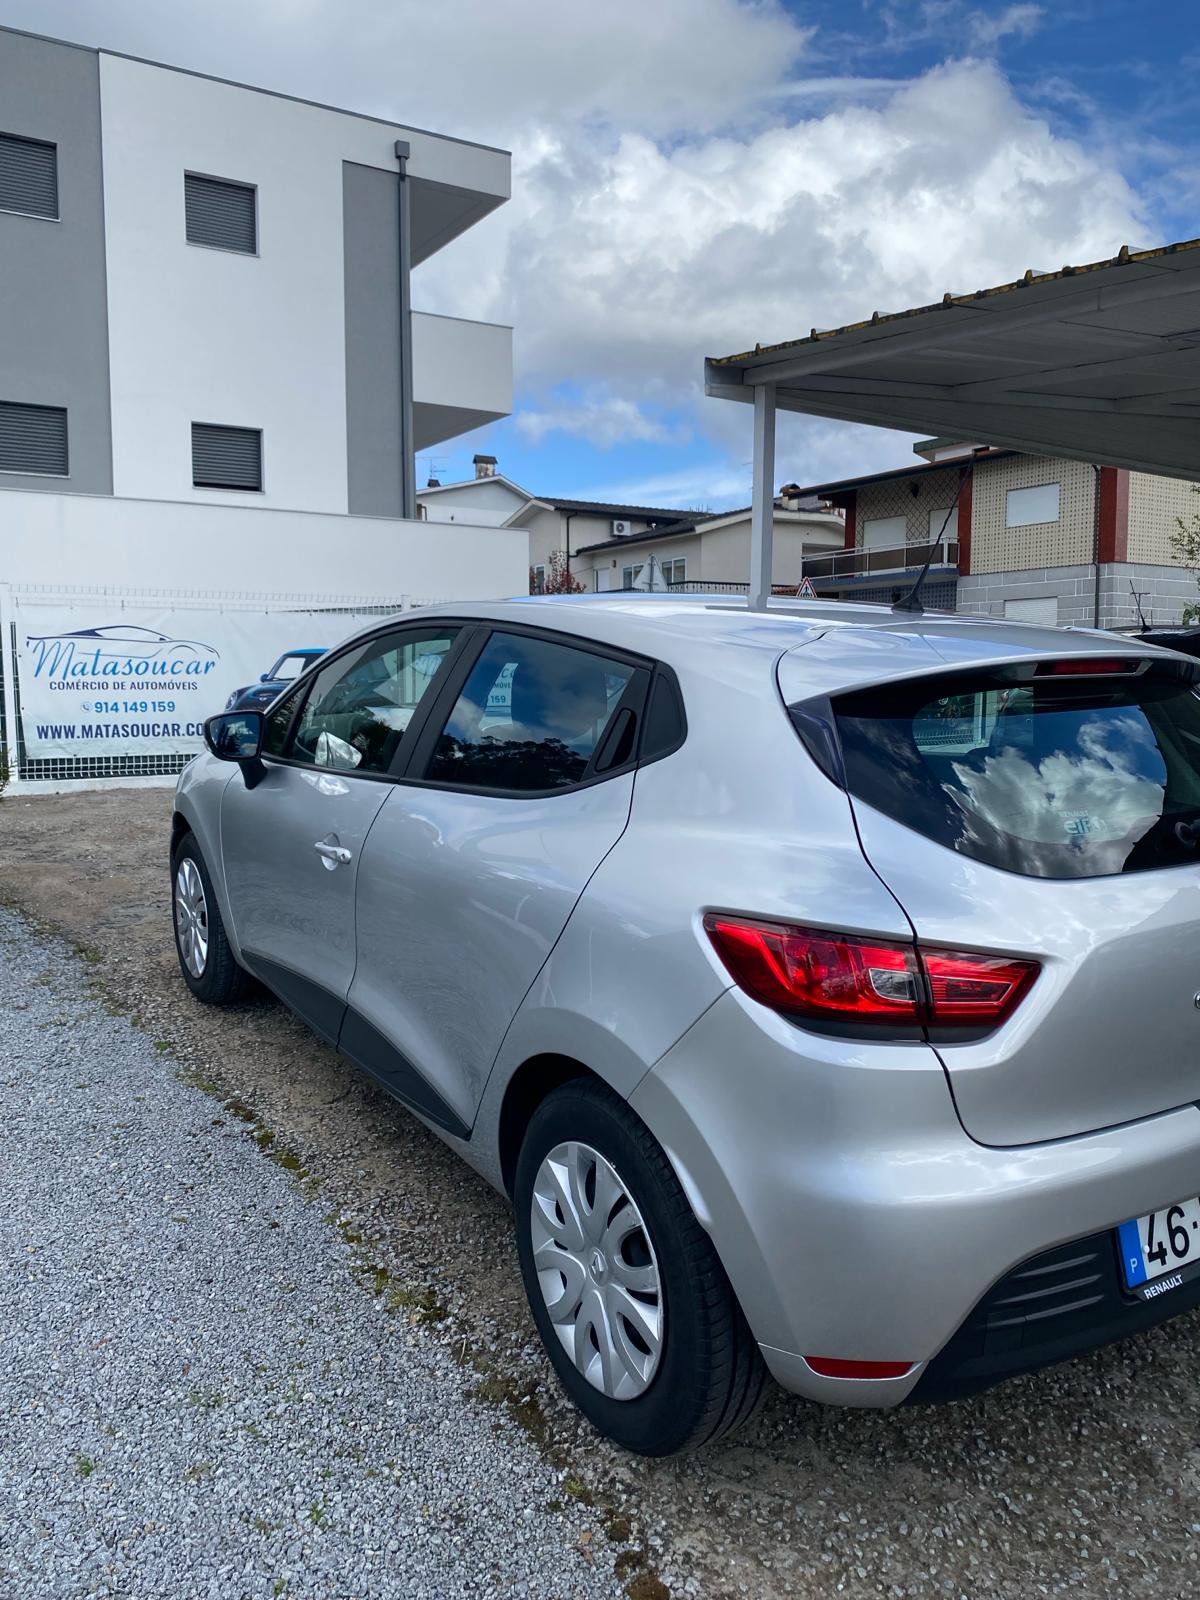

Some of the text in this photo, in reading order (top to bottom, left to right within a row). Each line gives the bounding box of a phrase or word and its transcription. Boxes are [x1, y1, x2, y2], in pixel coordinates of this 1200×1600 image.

[32, 640, 216, 680] Matasoucar
[50, 680, 198, 690] COMÉRCIO DE AUTOMÓVEIS
[94, 701, 176, 713] 914 149 159
[1147, 1197, 1200, 1266] 46-
[1130, 1257, 1138, 1274] P
[1143, 1274, 1184, 1300] RENAULT
